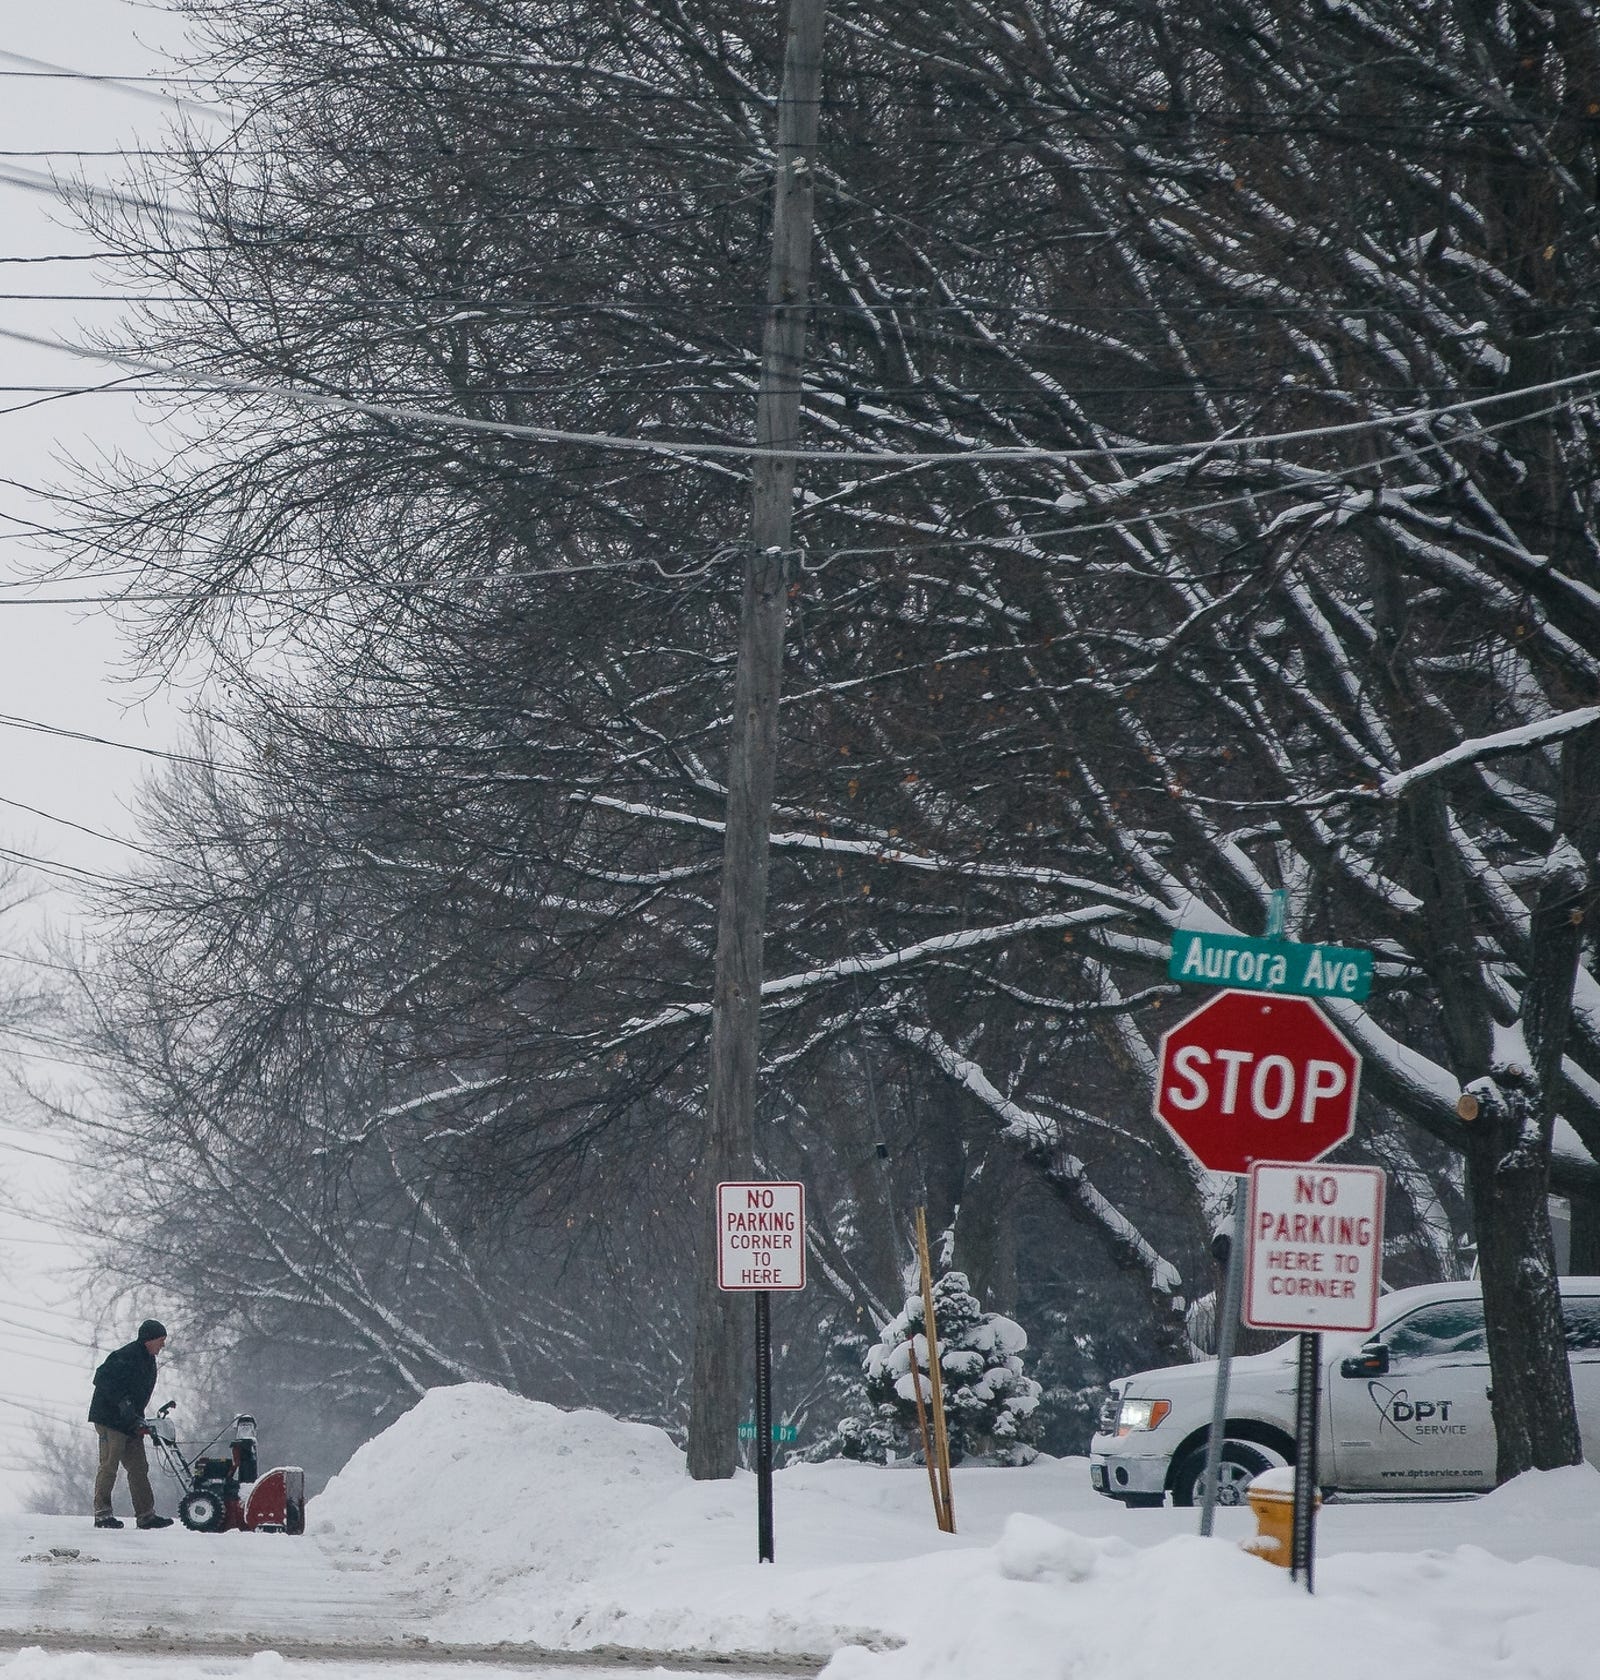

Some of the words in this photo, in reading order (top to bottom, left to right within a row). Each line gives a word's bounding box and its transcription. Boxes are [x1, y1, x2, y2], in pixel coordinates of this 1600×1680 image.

[1181, 936, 1287, 985] Aurora
[1302, 949, 1359, 993] Ave
[1168, 1045, 1347, 1124] STOP
[747, 1189, 774, 1209] NO
[1295, 1175, 1338, 1206] NO
[727, 1212, 795, 1232] PARKING
[1259, 1211, 1371, 1247] PARKING
[730, 1234, 792, 1249] CORNER
[752, 1251, 771, 1267] TO
[1267, 1251, 1324, 1272] HERE
[1335, 1253, 1360, 1274] TO
[741, 1269, 782, 1284] HERE
[1268, 1276, 1356, 1299] CORNER
[1392, 1400, 1453, 1422] DPT
[780, 1427, 792, 1441] Dr
[1415, 1425, 1467, 1435] SERVICE
[1381, 1469, 1484, 1479] www.dptservice.com
